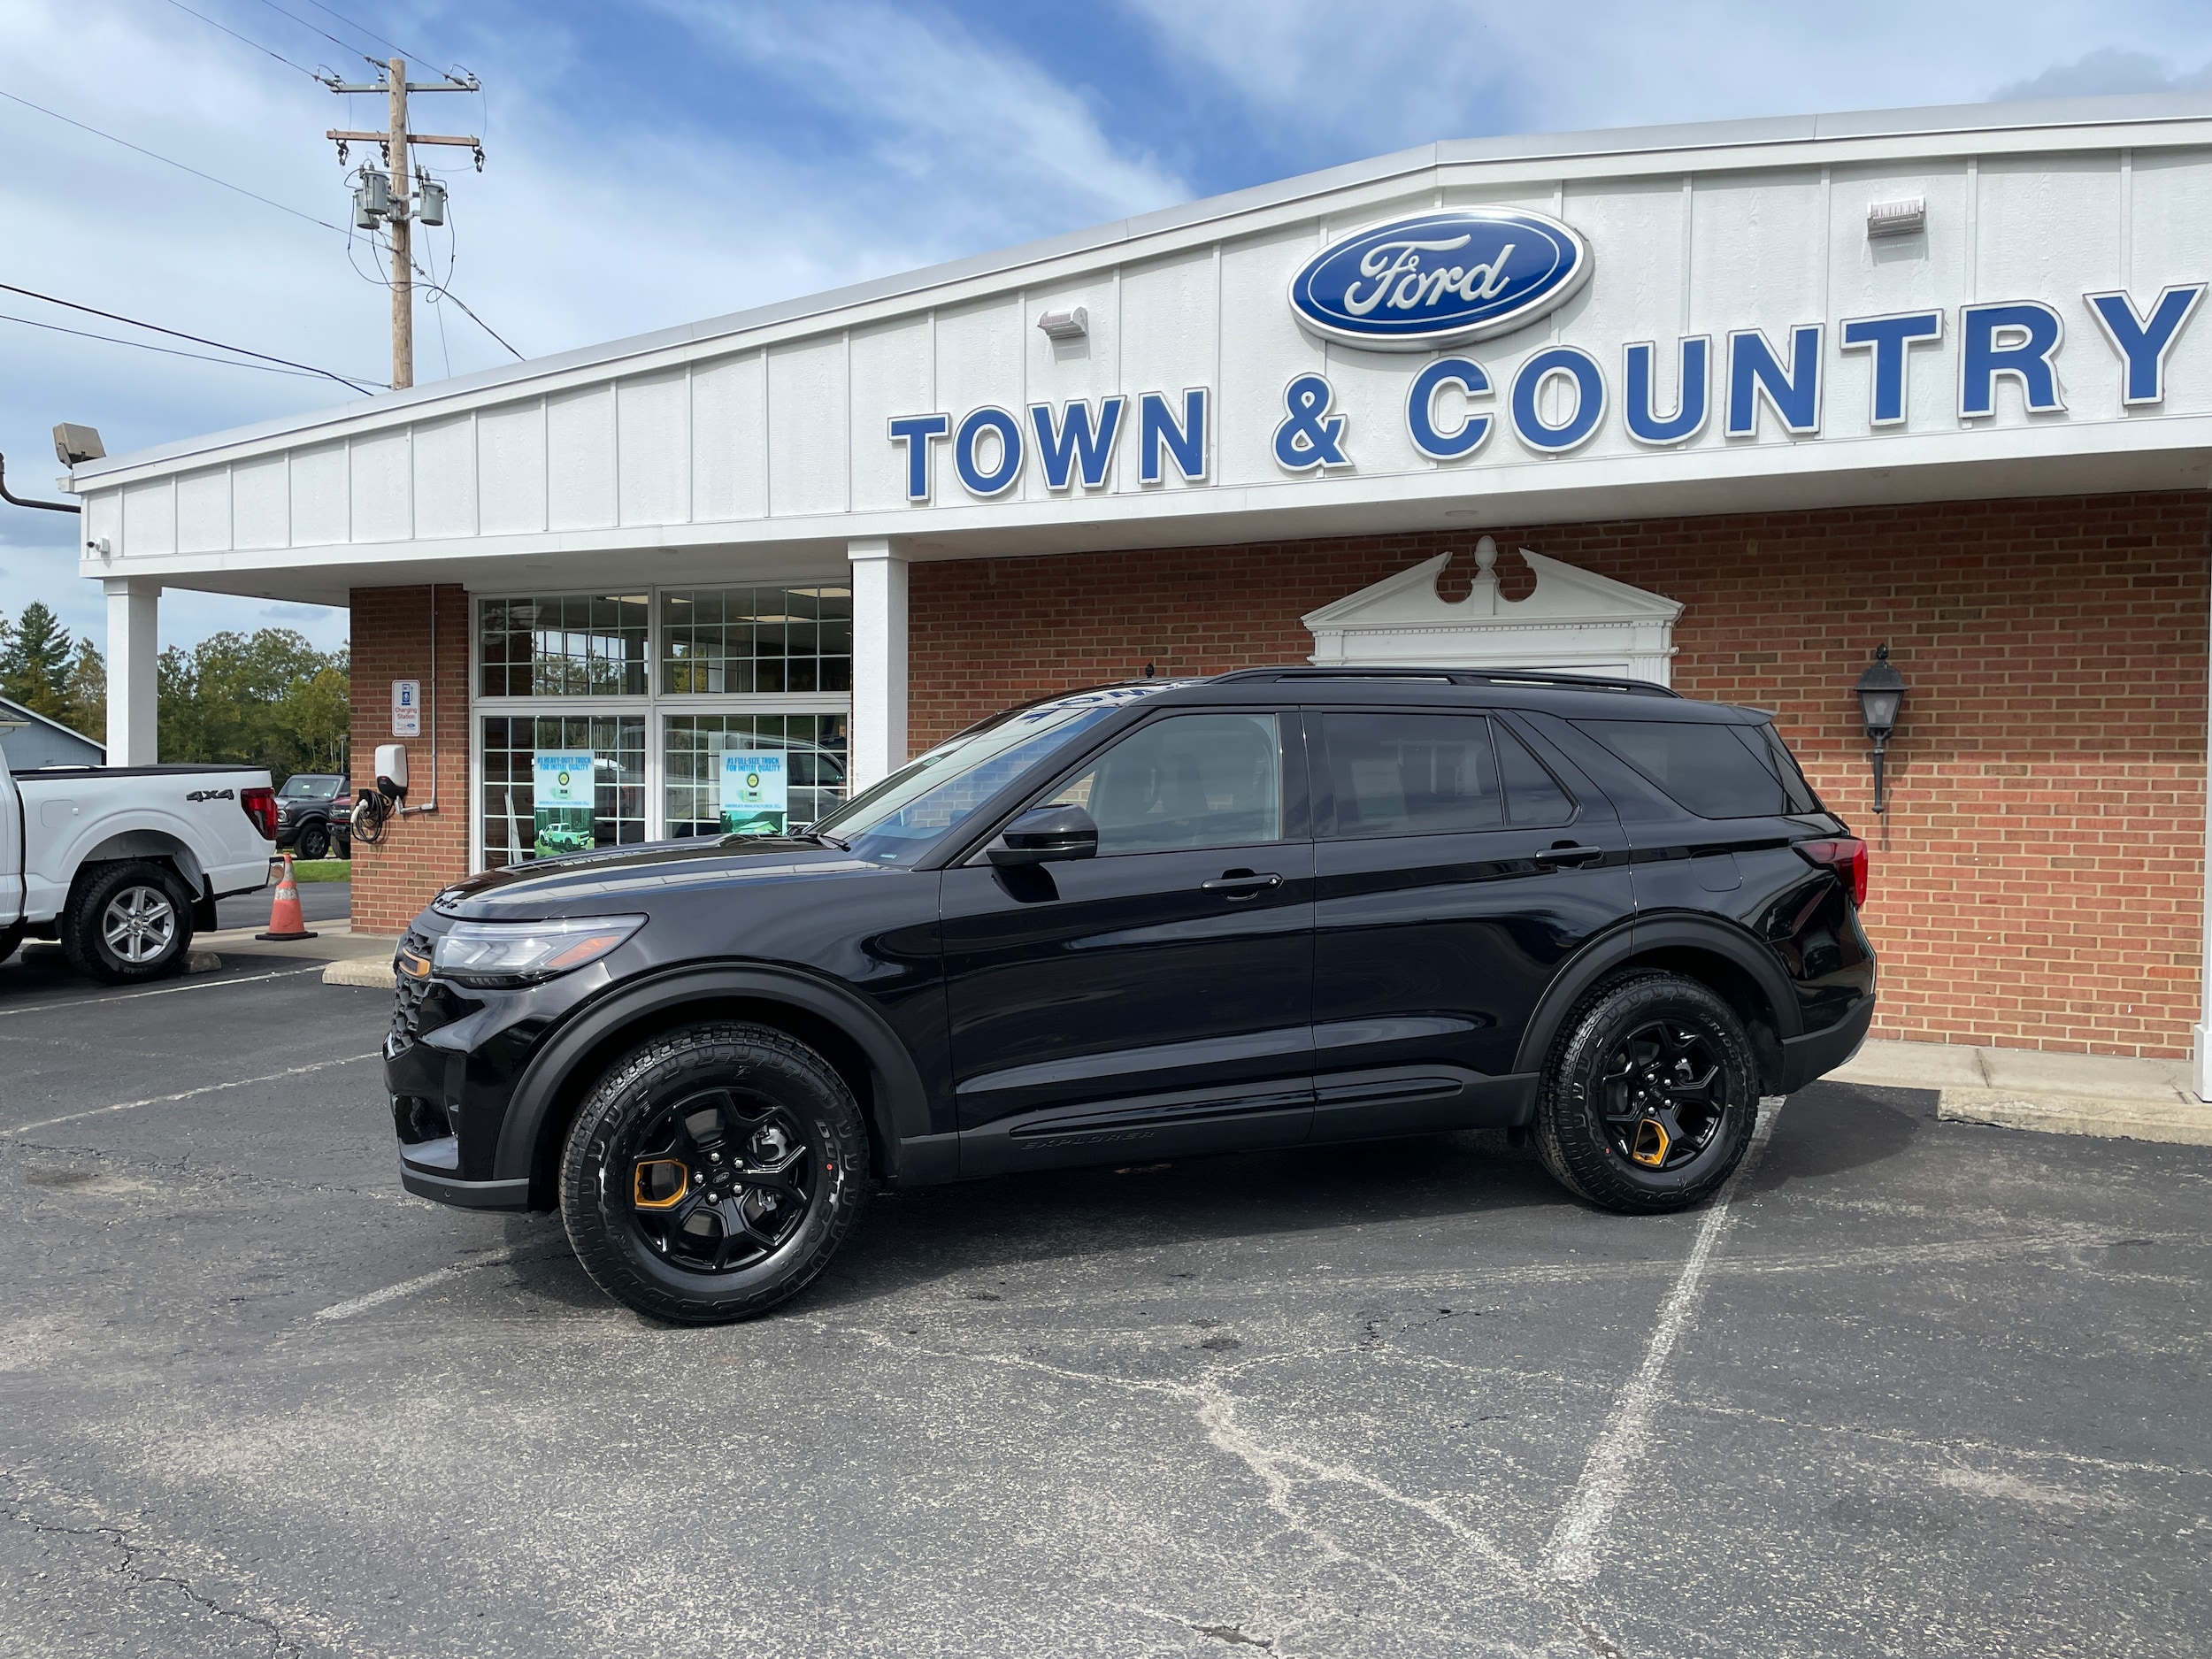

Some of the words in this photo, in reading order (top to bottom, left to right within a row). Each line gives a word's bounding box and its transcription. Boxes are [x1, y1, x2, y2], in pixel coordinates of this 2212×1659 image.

[1344, 234, 1515, 316] Ford
[887, 387, 1210, 502] TOWN
[1271, 373, 1355, 473] &
[1405, 281, 2209, 461] COUNTRY
[1019, 1131, 1155, 1150] EXPLORER
